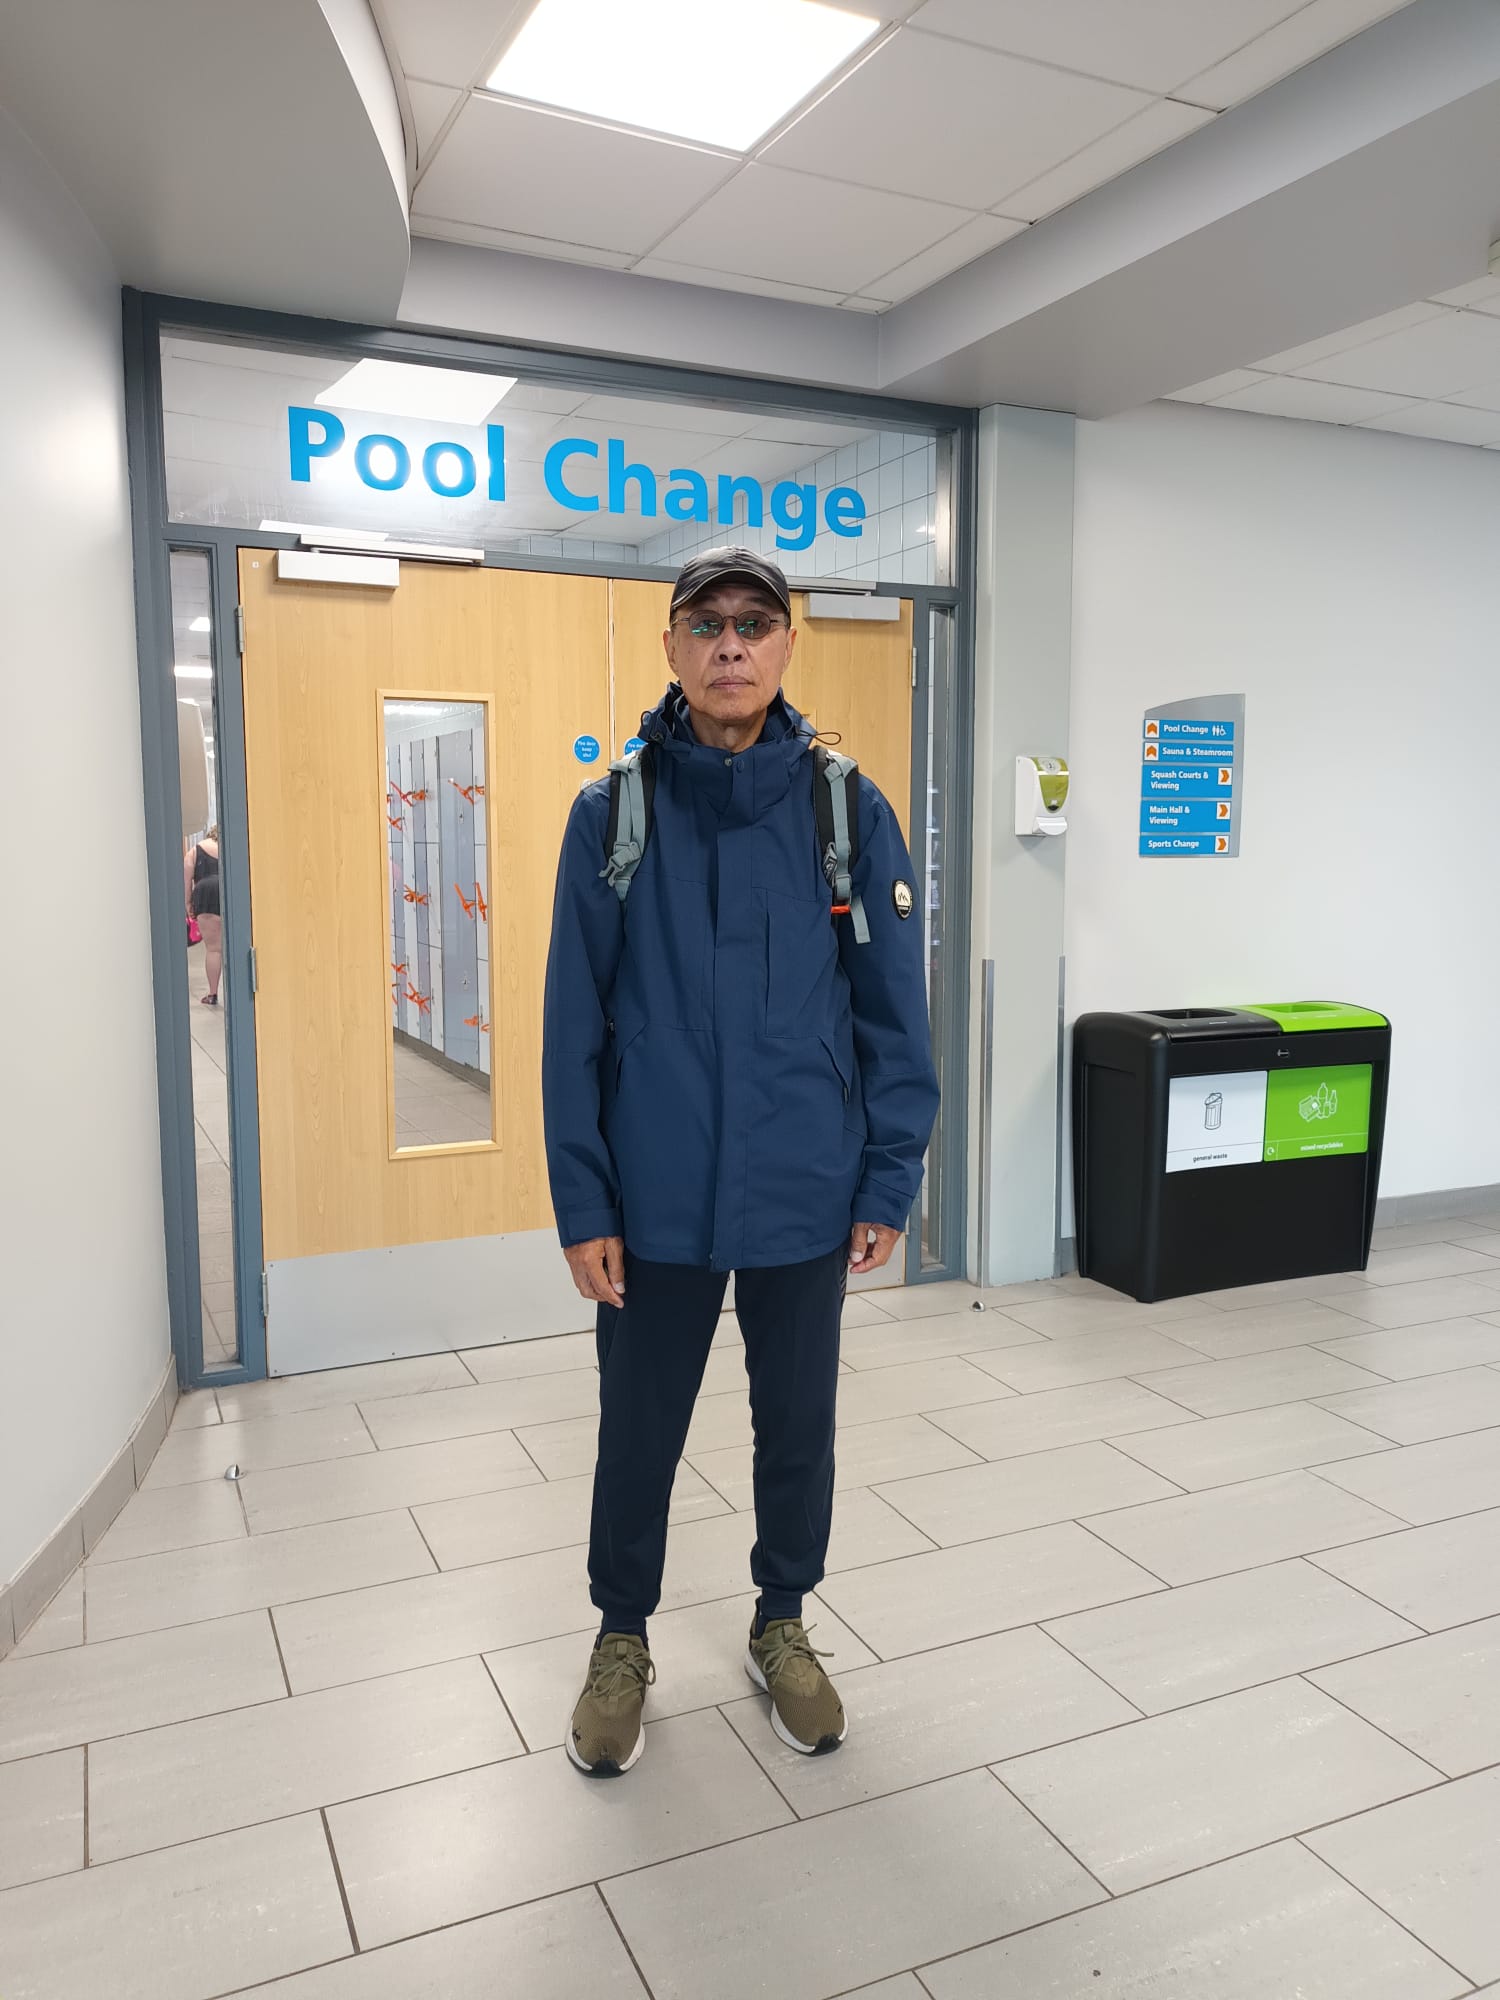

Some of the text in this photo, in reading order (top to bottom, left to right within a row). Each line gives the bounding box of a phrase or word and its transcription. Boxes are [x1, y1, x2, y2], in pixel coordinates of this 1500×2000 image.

[287, 405, 867, 552] Pool Change
[1163, 724, 1209, 735] Pool Change
[1162, 747, 1185, 755] Sauna
[1193, 748, 1233, 756] Steamroom
[1151, 770, 1177, 780] Squash
[1178, 771, 1202, 779] Courts
[1151, 781, 1180, 791] Viewing
[1149, 806, 1168, 814] Main
[1169, 806, 1183, 814] Hall
[1149, 816, 1178, 826] Viewing
[1148, 840, 1200, 849] Sports Change
[1193, 1154, 1213, 1162] general
